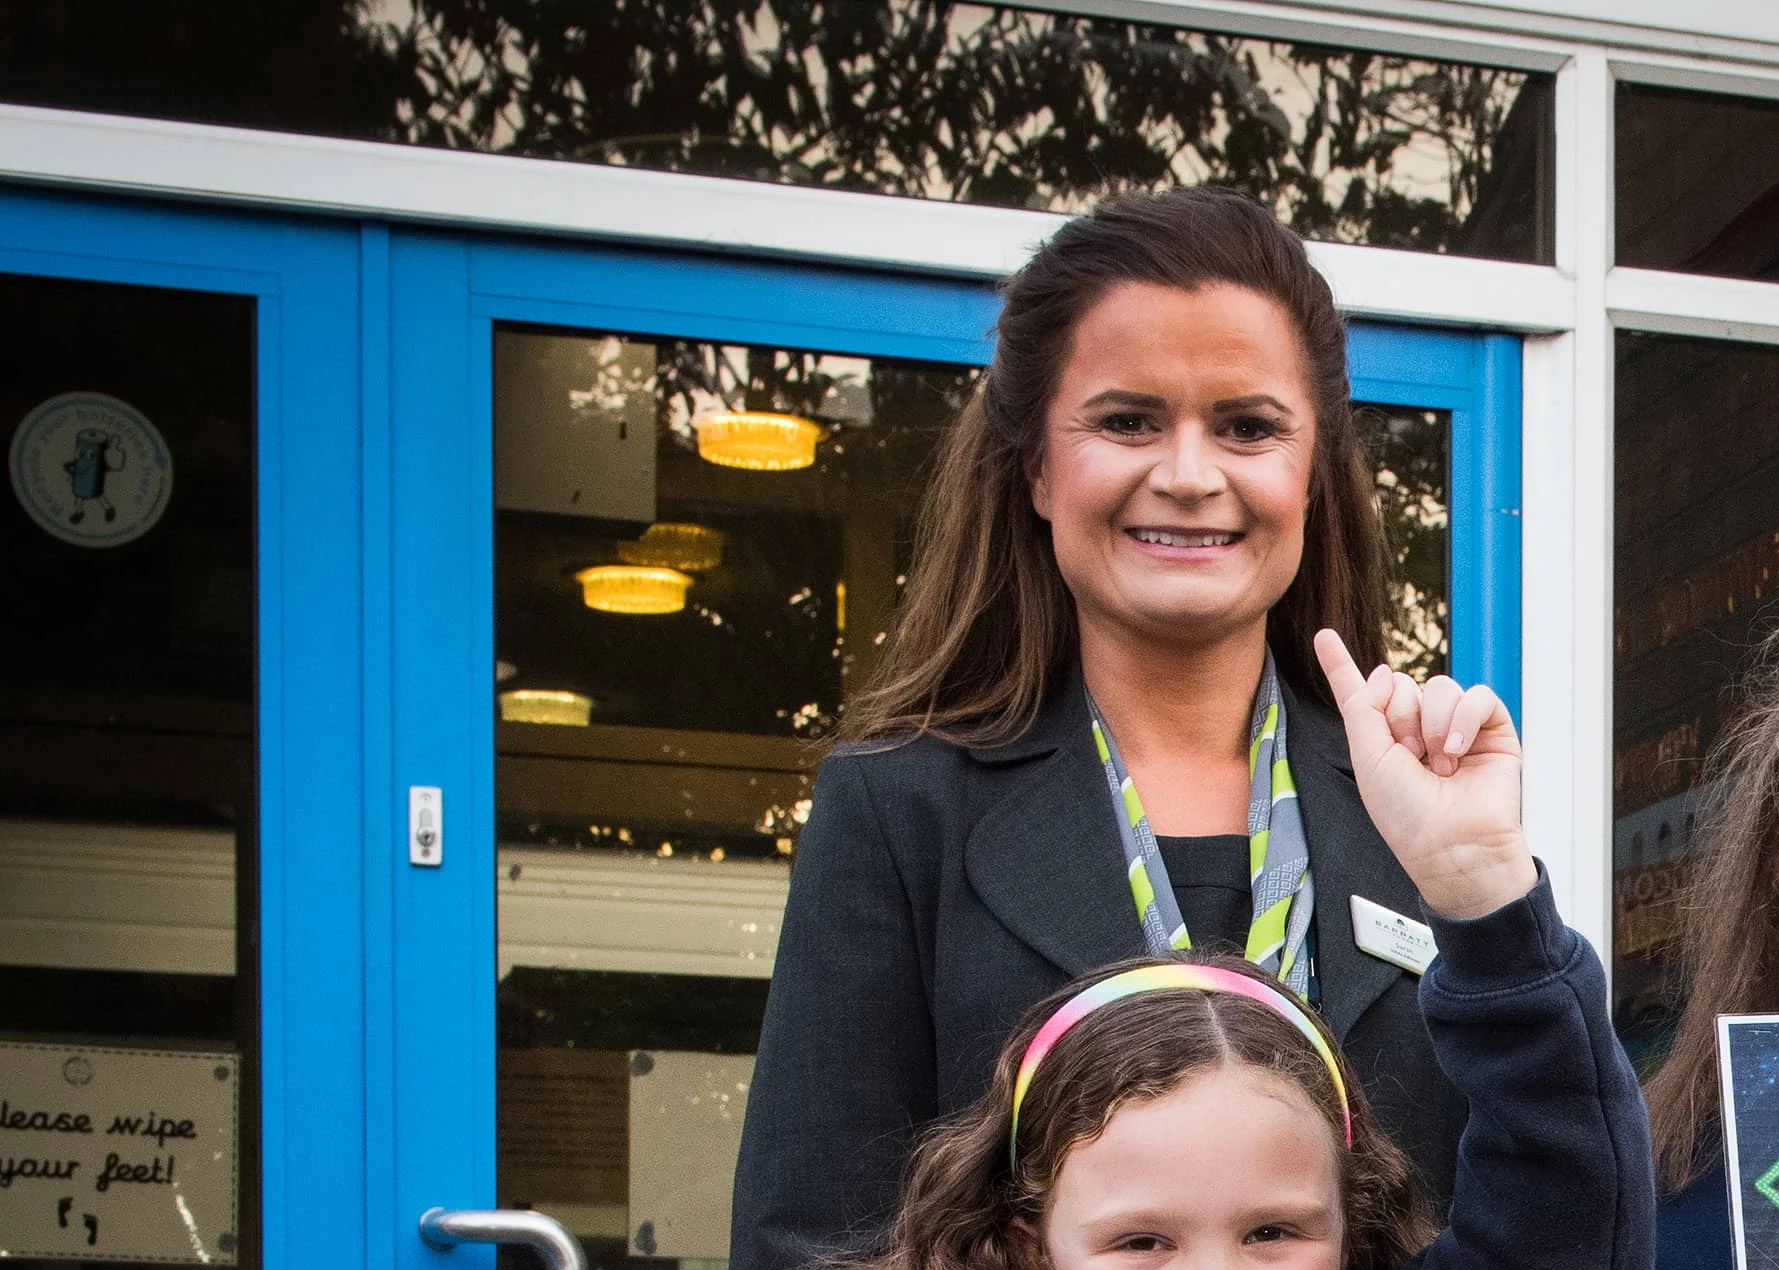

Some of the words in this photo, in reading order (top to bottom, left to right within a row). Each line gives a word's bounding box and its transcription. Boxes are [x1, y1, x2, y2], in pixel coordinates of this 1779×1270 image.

[0, 1101, 93, 1134] lease
[106, 1111, 197, 1148] wipe
[0, 1159, 81, 1189] your
[95, 1153, 175, 1193] feet!
